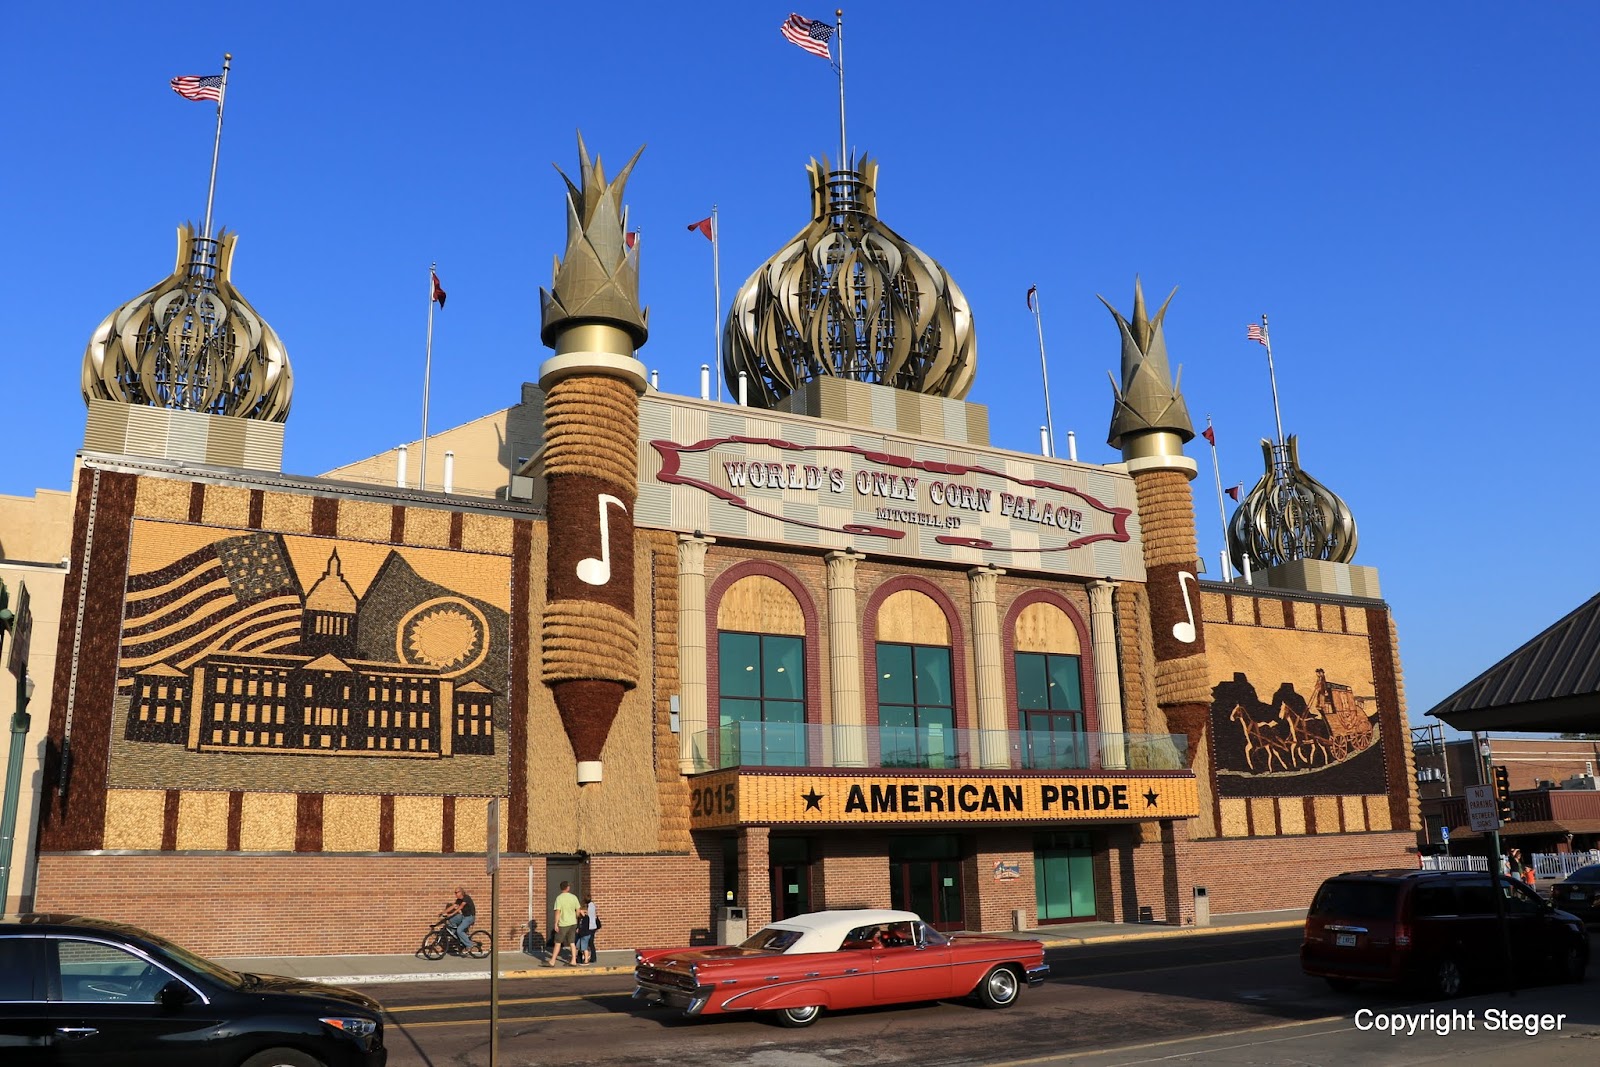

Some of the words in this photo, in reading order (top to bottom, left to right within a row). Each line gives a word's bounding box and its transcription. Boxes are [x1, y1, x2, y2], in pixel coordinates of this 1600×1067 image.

[723, 461, 845, 493] WORLD'S
[856, 470, 919, 501] ONLY
[929, 480, 992, 513] CORN
[1000, 492, 1083, 533] PALACE
[876, 507, 944, 529] MITCHELL,
[945, 516, 961, 529] SD
[691, 783, 736, 817] 2015
[845, 784, 1023, 813] AMERICAN
[1041, 785, 1128, 811] PRIDE
[1470, 800, 1493, 809] PARKING
[1474, 790, 1484, 798] NO
[1477, 820, 1492, 828] SIGNS
